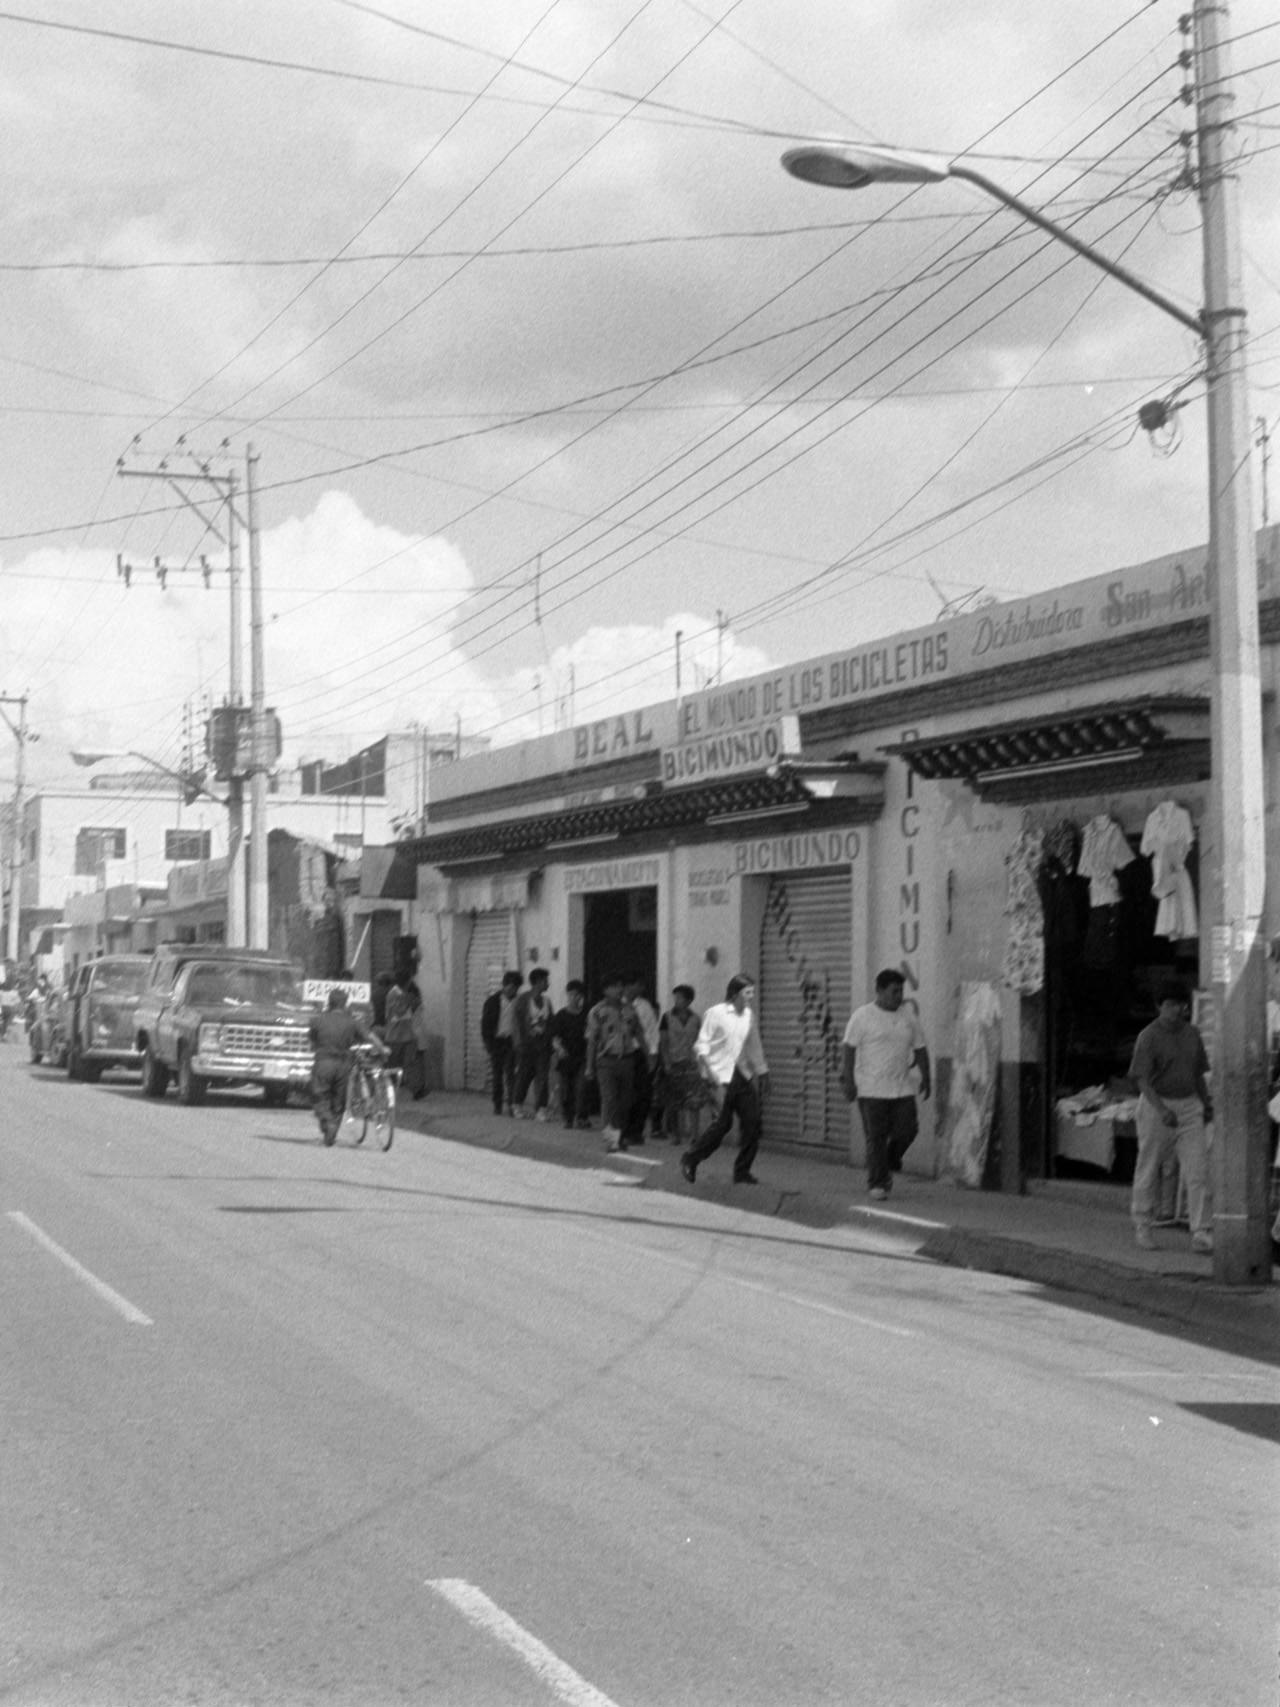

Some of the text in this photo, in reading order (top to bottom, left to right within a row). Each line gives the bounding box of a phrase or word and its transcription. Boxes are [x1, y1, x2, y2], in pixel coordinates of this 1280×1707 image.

[1102, 581, 1152, 628] San
[684, 631, 949, 736] EL MUNDO DE LAS BICICLETAS
[573, 709, 654, 760] BEAL
[663, 727, 779, 781] BICIMUNDO
[735, 830, 861, 872] BICIMUNDO
